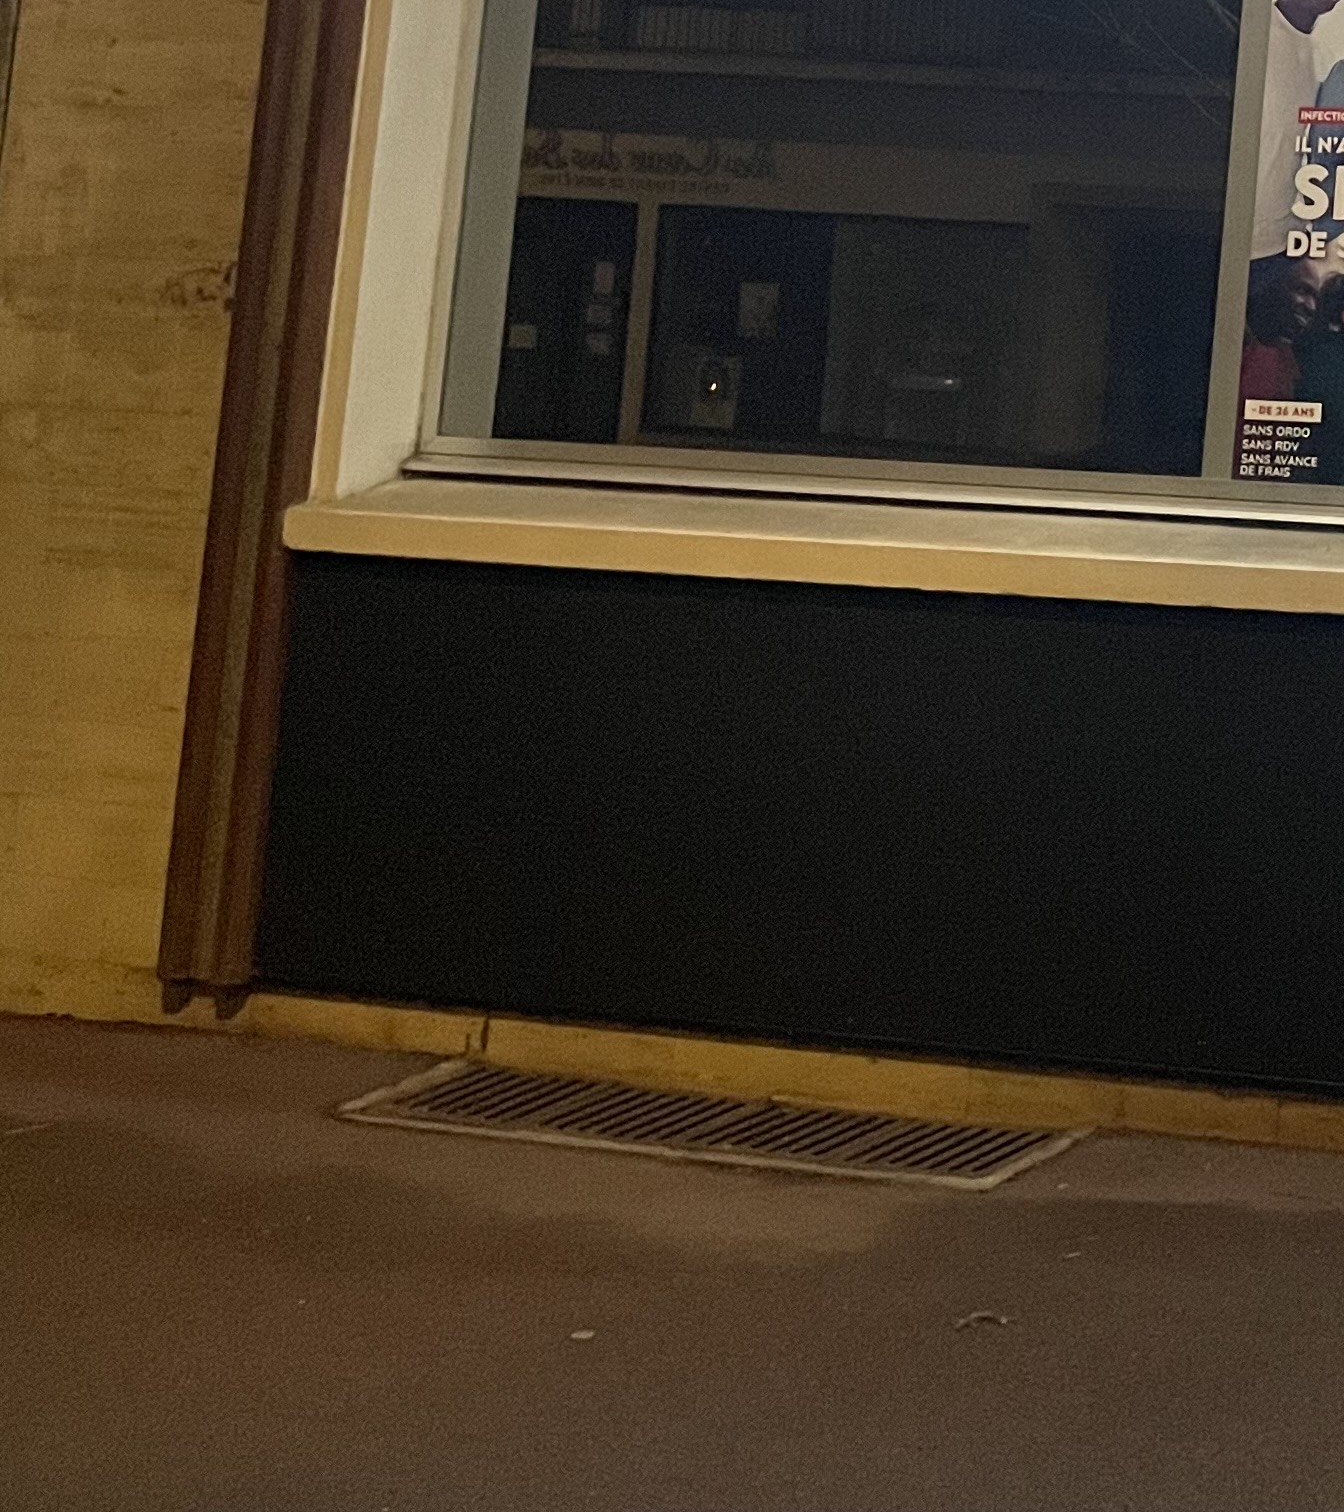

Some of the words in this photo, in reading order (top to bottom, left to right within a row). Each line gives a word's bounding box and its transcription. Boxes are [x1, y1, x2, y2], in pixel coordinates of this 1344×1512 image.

[1294, 135, 1311, 153] IL
[1286, 230, 1327, 258] DE
[1292, 407, 1315, 417] ANS
[1243, 424, 1274, 436] SANS
[1275, 426, 1311, 438] ORDO
[1242, 439, 1272, 451] SANS
[1275, 440, 1300, 452] RDV
[1241, 453, 1271, 465] SANS
[1274, 455, 1318, 468] AVANCE
[1239, 465, 1255, 476] DE
[1258, 466, 1291, 477] FRAIS
